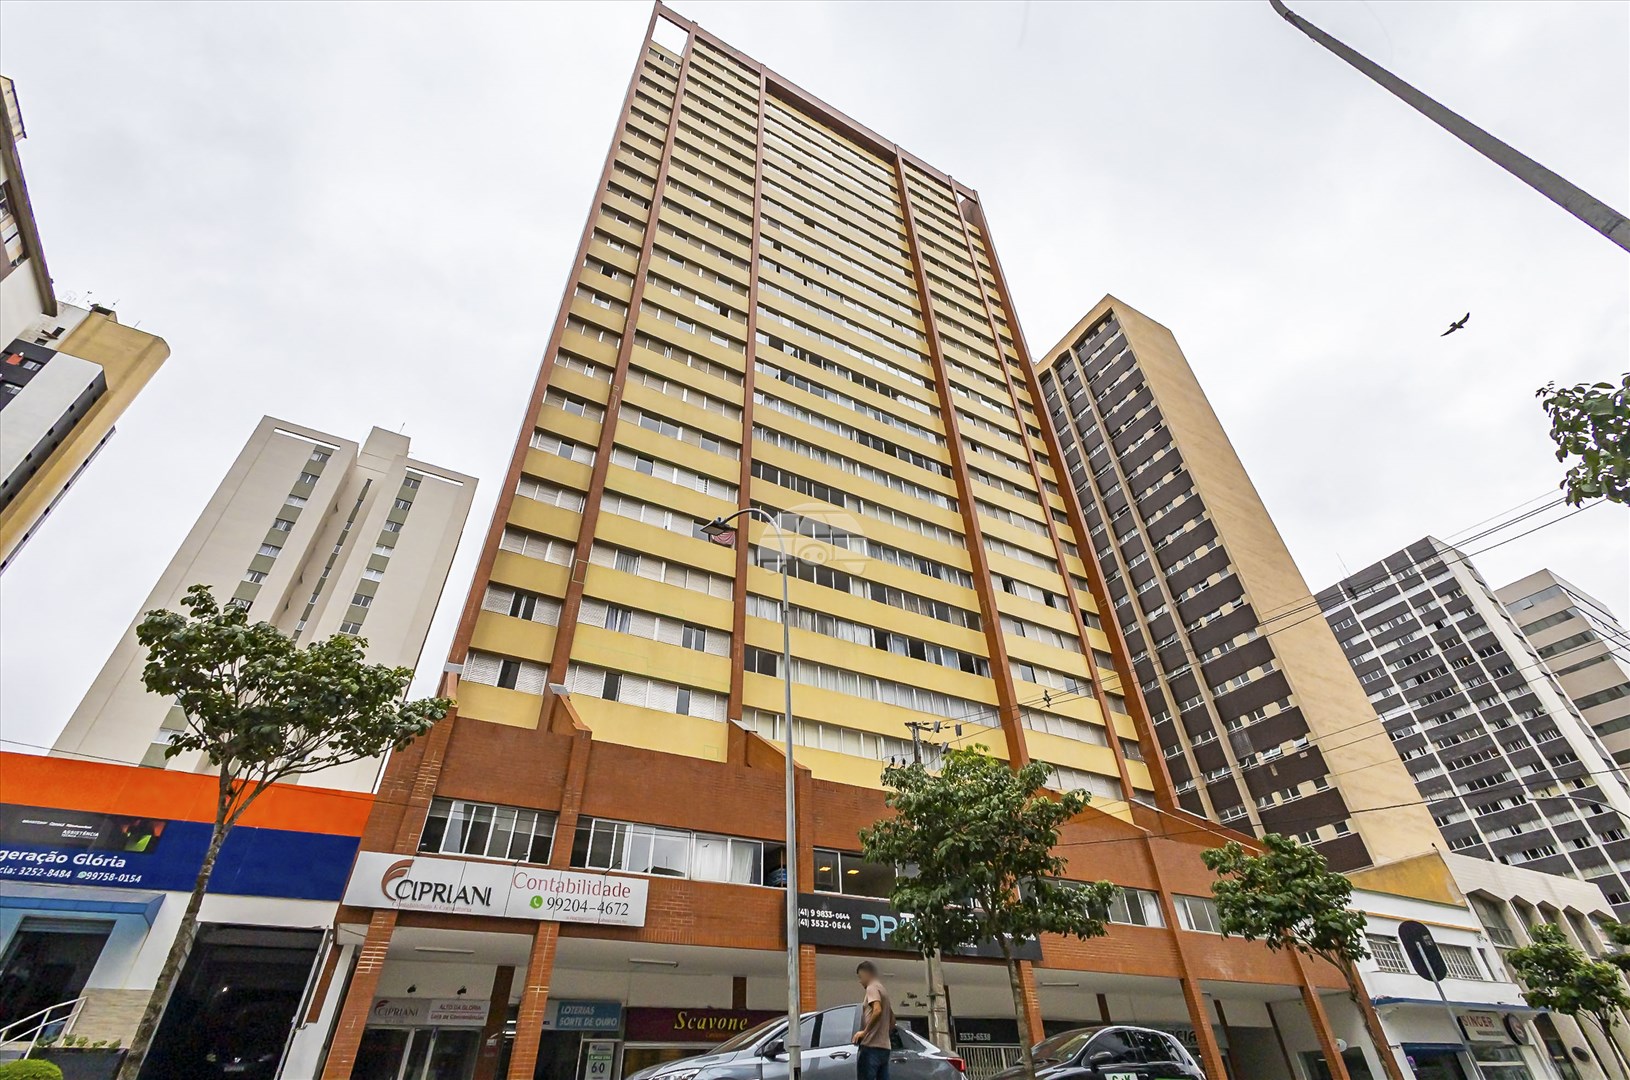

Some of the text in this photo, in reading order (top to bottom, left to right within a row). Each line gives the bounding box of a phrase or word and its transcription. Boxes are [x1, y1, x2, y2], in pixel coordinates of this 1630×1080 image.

[73, 853, 126, 868] Glória
[18, 866, 72, 878] 3252-8484
[395, 879, 492, 906] CIPRIANI
[513, 872, 631, 898] Contabilidade
[547, 897, 629, 916] 99204-4672
[561, 1005, 595, 1015] LOTERIAS
[674, 1011, 748, 1030] Scavone
[1460, 1015, 1495, 1028] SINGER
